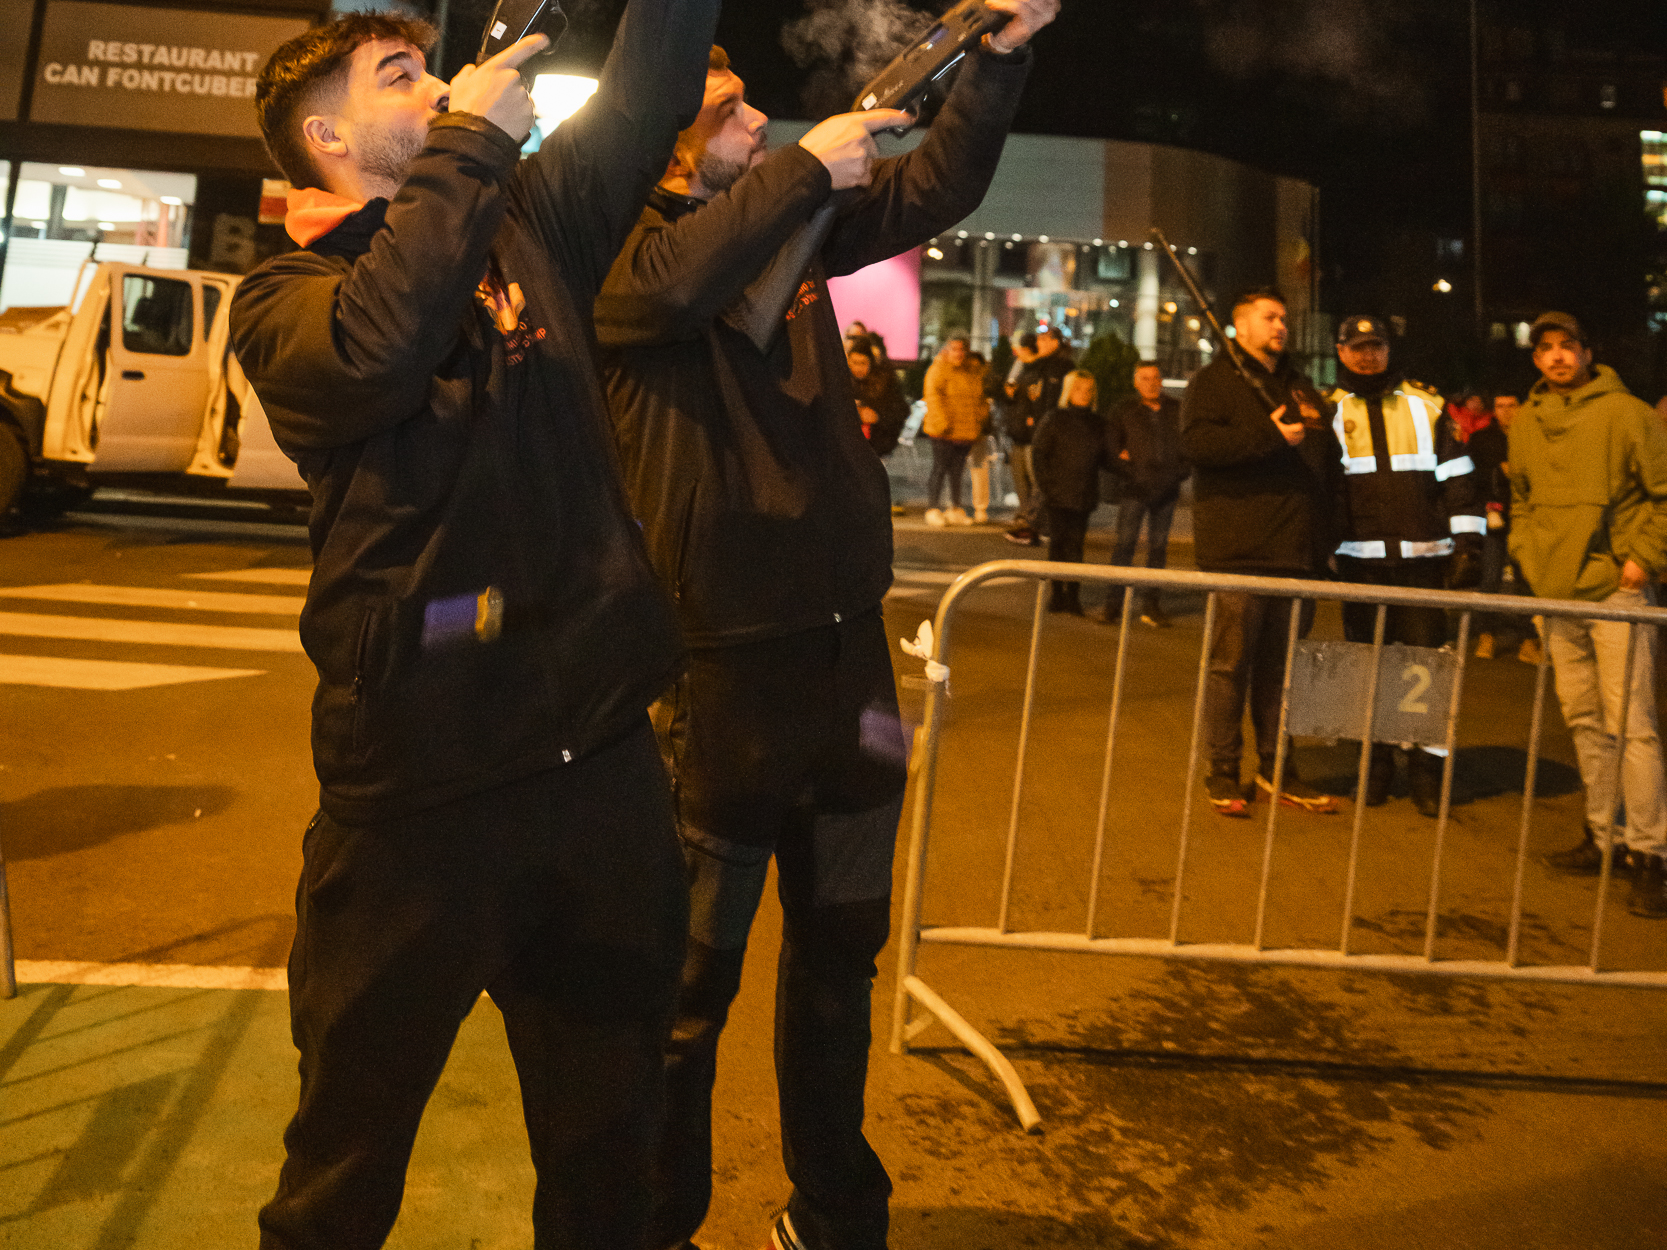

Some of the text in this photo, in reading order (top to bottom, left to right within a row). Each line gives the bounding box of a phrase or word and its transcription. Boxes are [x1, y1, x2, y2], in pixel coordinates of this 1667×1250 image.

[88, 39, 259, 72] RESTAURANT
[44, 61, 99, 87] CAN
[1399, 664, 1432, 714] 2
